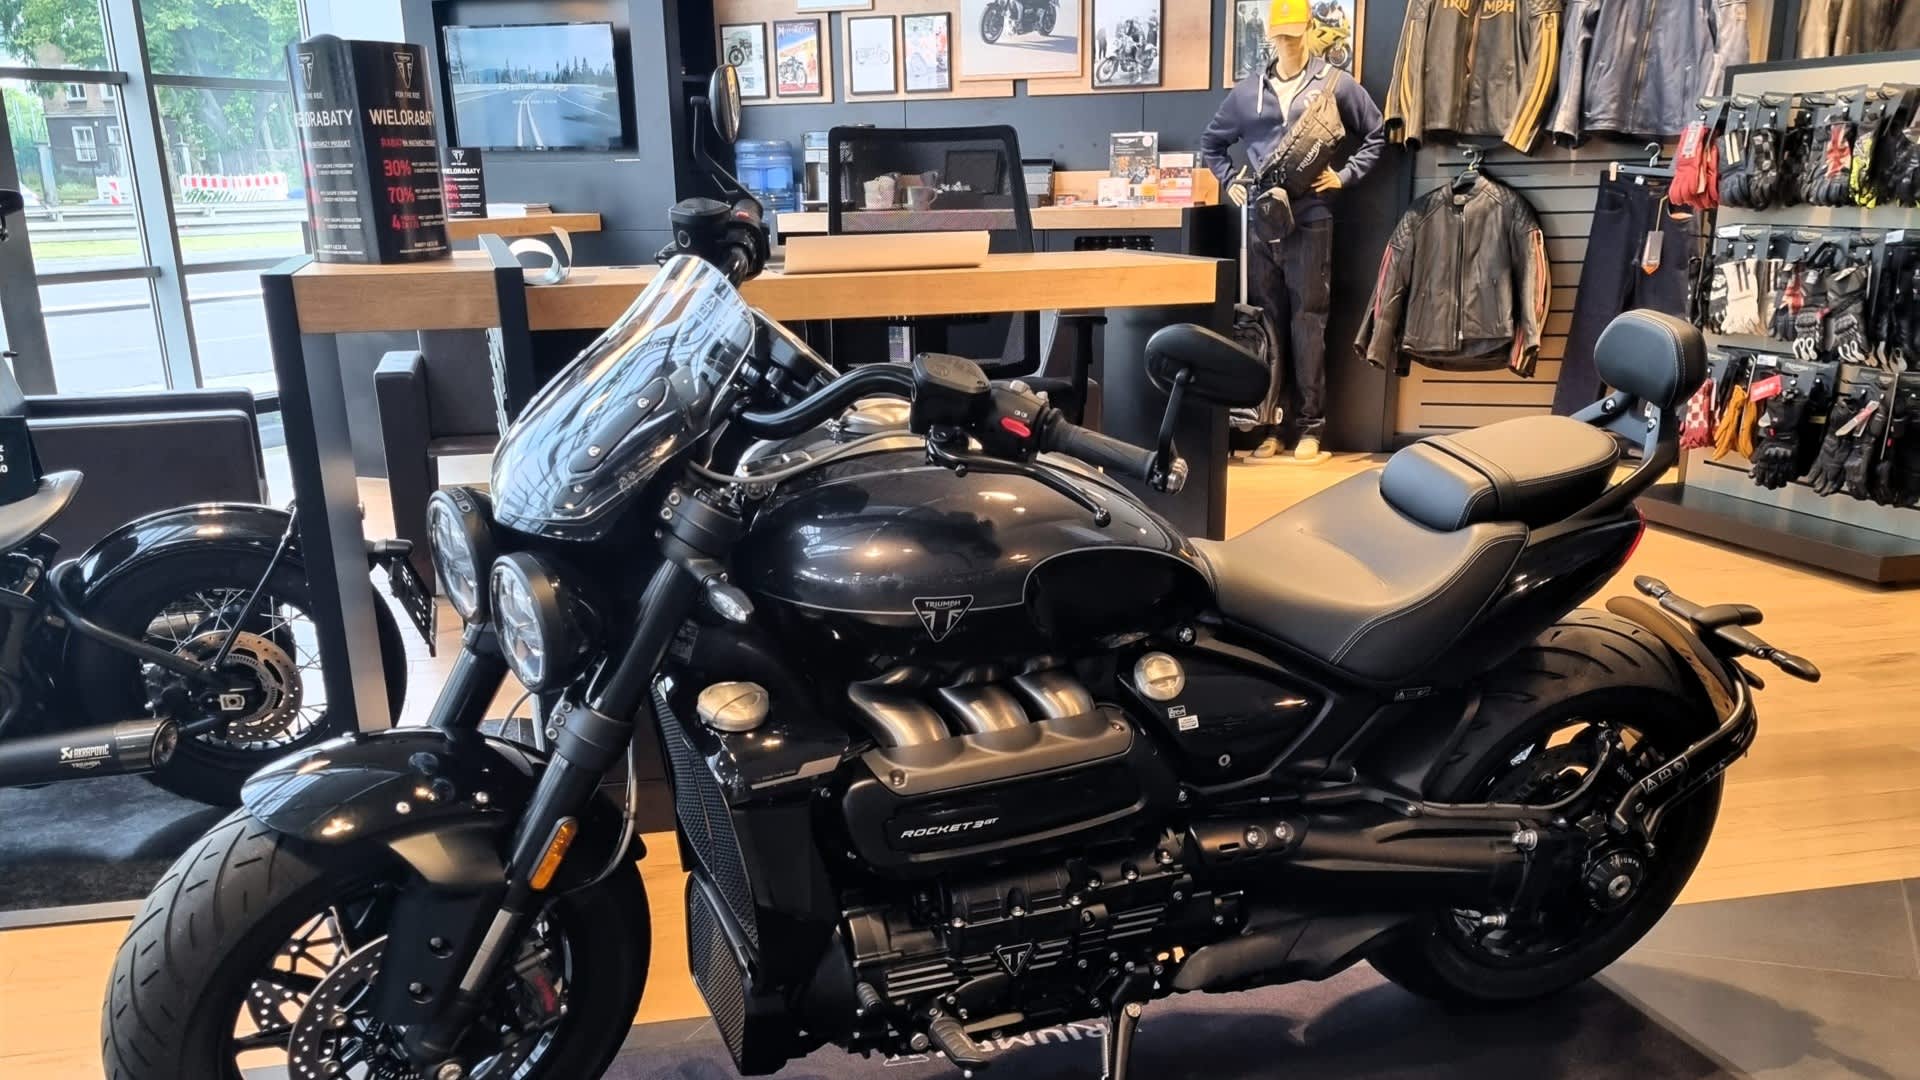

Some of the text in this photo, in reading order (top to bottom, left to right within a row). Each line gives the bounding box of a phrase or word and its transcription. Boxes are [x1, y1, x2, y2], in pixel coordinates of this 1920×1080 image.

[1296, 138, 1323, 172] TRIUMPH
[383, 160, 412, 177] 30%
[387, 187, 415, 204] 70%
[925, 600, 961, 608] TRIUMPH
